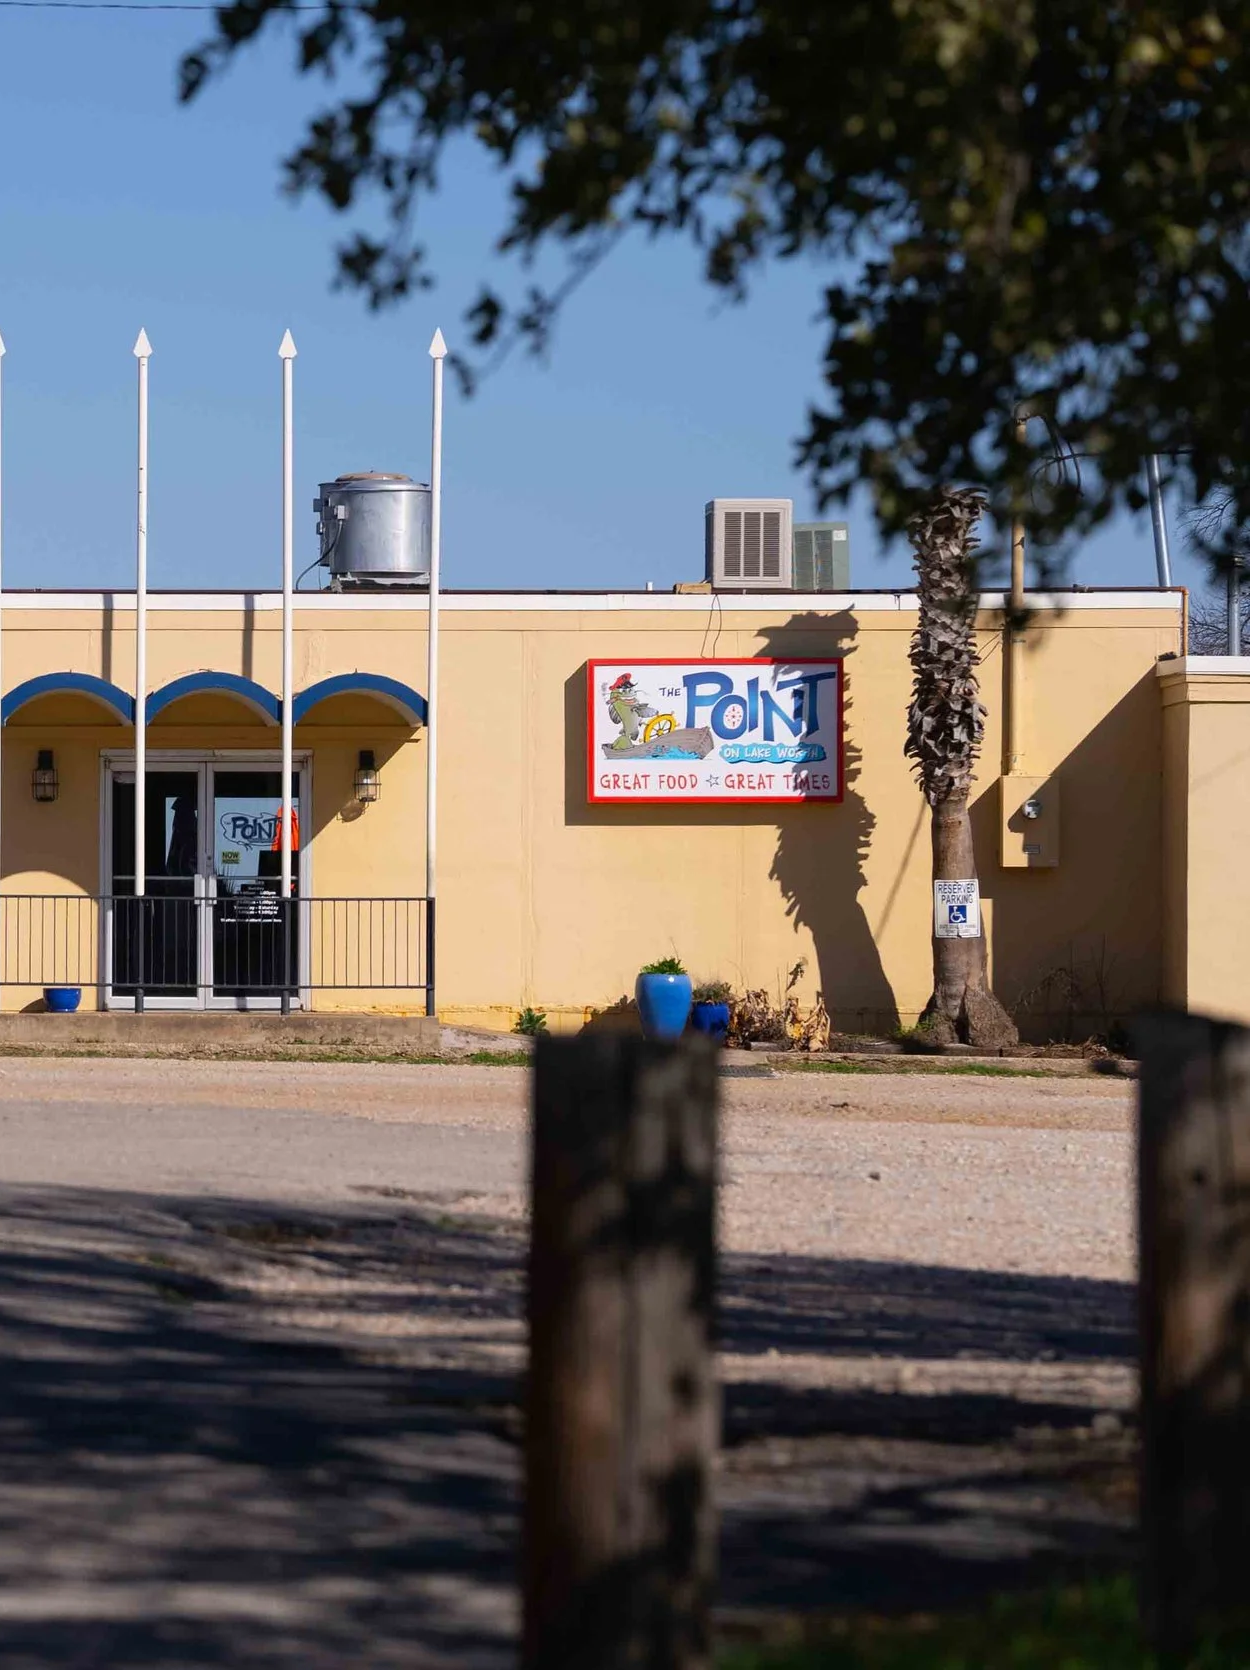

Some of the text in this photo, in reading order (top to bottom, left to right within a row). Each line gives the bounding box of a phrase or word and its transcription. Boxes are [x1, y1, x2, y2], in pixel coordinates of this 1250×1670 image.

[659, 671, 836, 742] THE POINT
[723, 747, 739, 758] ON
[744, 747, 770, 758] LAKE
[600, 773, 830, 791] GREAT FOOD GREAT TIMES
[231, 816, 283, 840] POINT
[222, 851, 240, 859] NOW
[938, 883, 975, 894] RESERVED
[941, 894, 973, 904] PARKING
